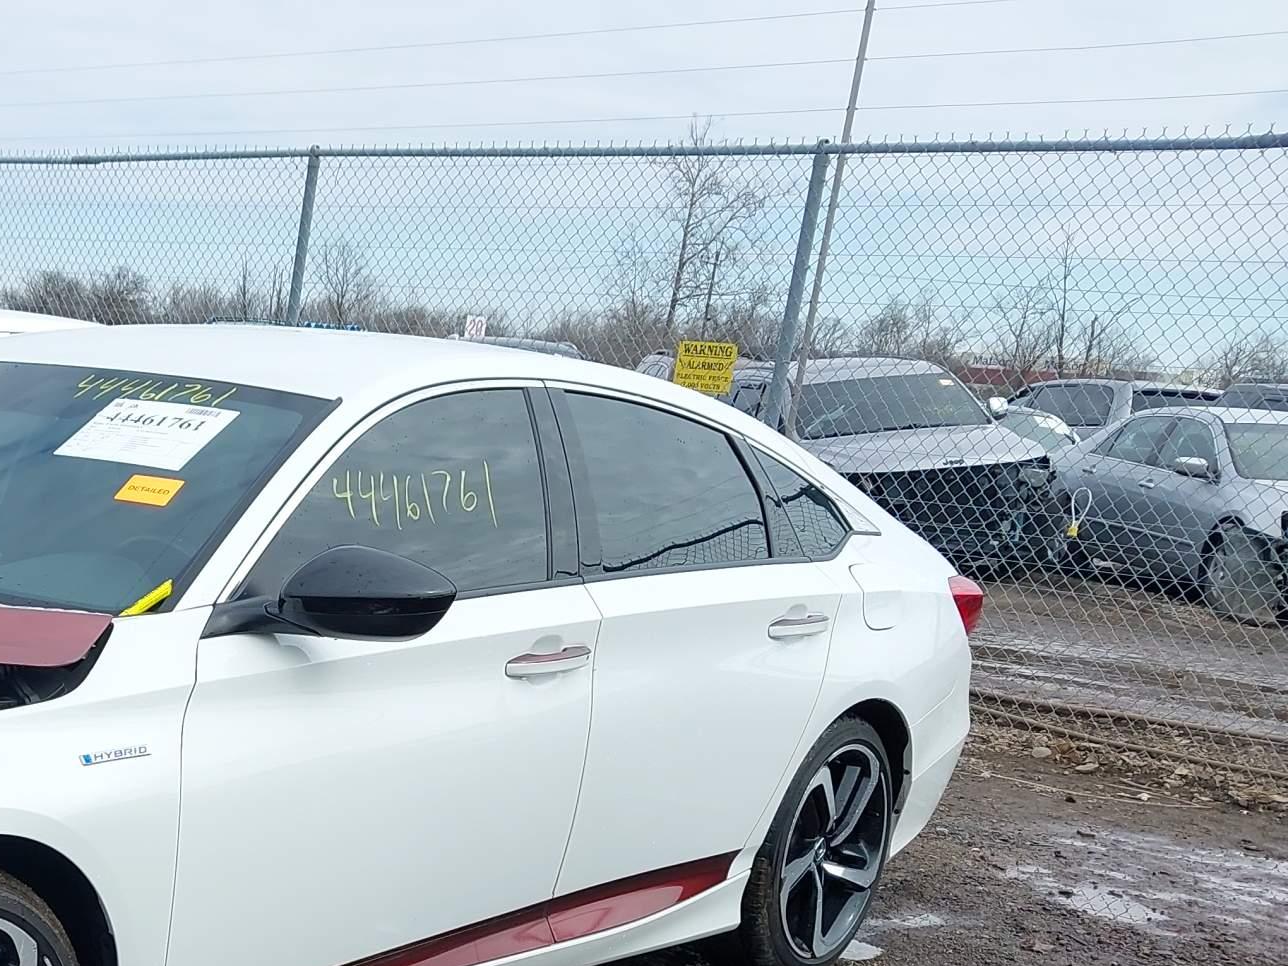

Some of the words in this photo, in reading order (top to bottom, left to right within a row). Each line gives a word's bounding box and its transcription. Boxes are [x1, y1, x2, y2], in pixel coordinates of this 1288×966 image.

[683, 343, 733, 357] WARNING
[686, 359, 725, 371] ALARMED
[677, 372, 706, 381] ELECTRIC
[73, 374, 237, 407] 44461761
[106, 411, 207, 432] 44461761
[127, 483, 171, 496] DETAILED
[332, 459, 499, 531] 44461761
[93, 745, 148, 762] HYBRID
